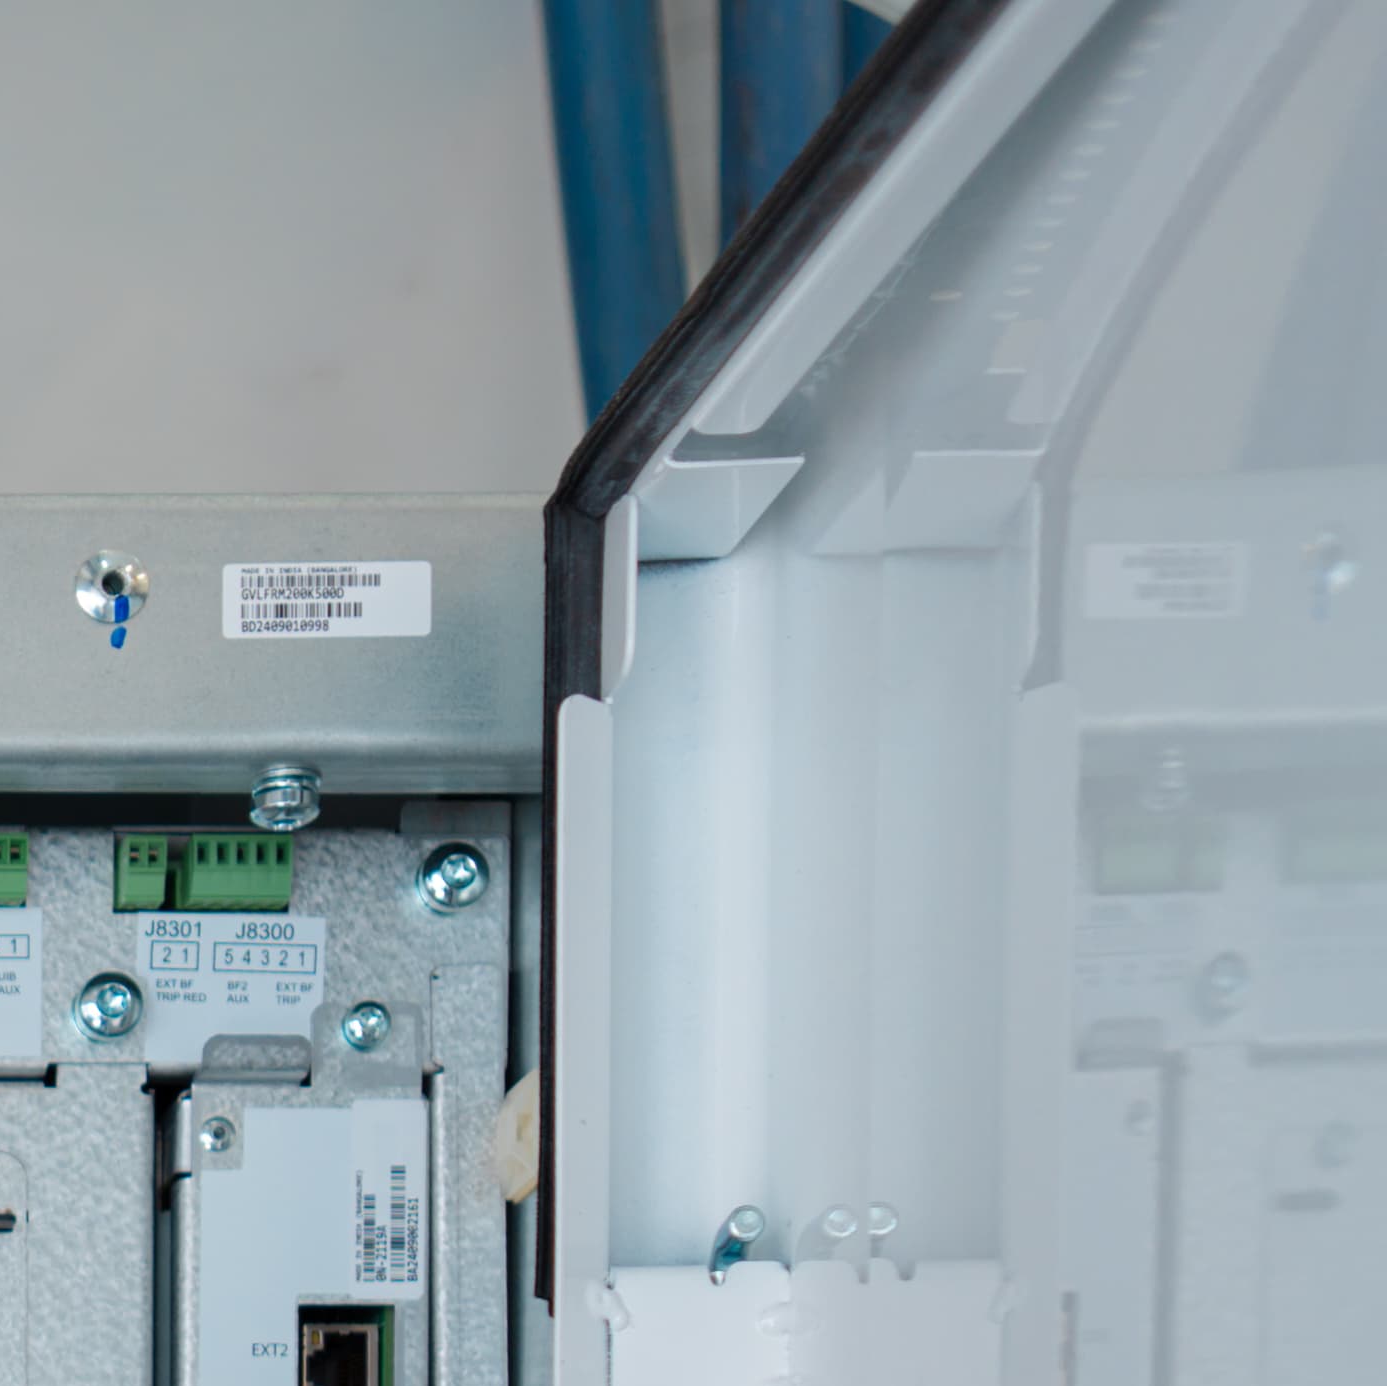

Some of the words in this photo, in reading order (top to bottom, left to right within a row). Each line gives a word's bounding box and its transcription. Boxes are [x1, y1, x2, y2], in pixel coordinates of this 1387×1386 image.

[145, 920, 201, 938] J8301
[235, 922, 295, 940] J8300
[156, 979, 177, 988] EXT
[181, 979, 194, 989] BF
[227, 982, 248, 991] BF2
[276, 982, 297, 992] EXT
[301, 982, 314, 992] BF
[157, 992, 180, 1002] TRIP
[183, 992, 207, 1002] RED
[227, 994, 249, 1004] AUX
[276, 994, 301, 1004] TRIP
[251, 1343, 289, 1358] EXT2
